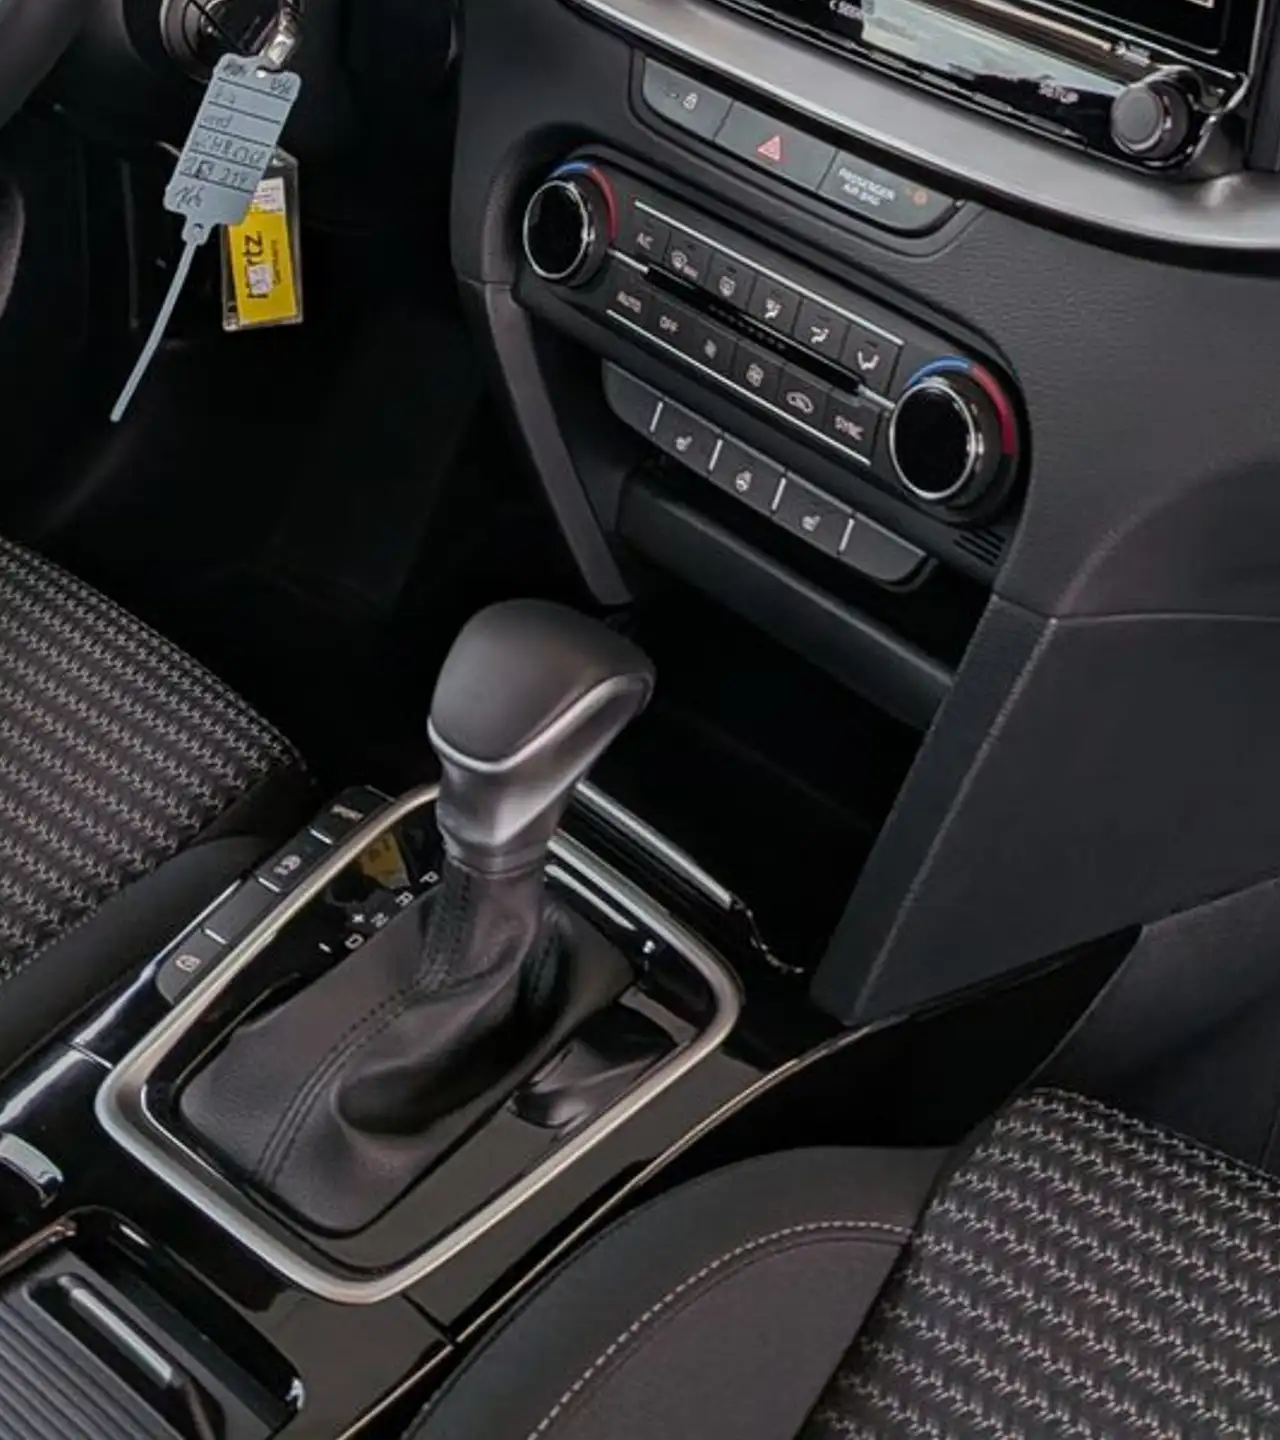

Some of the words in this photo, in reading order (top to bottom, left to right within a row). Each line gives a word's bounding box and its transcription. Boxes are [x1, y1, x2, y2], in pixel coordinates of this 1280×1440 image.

[419, 870, 441, 885] P
[394, 891, 415, 907] R
[344, 932, 366, 950] D
